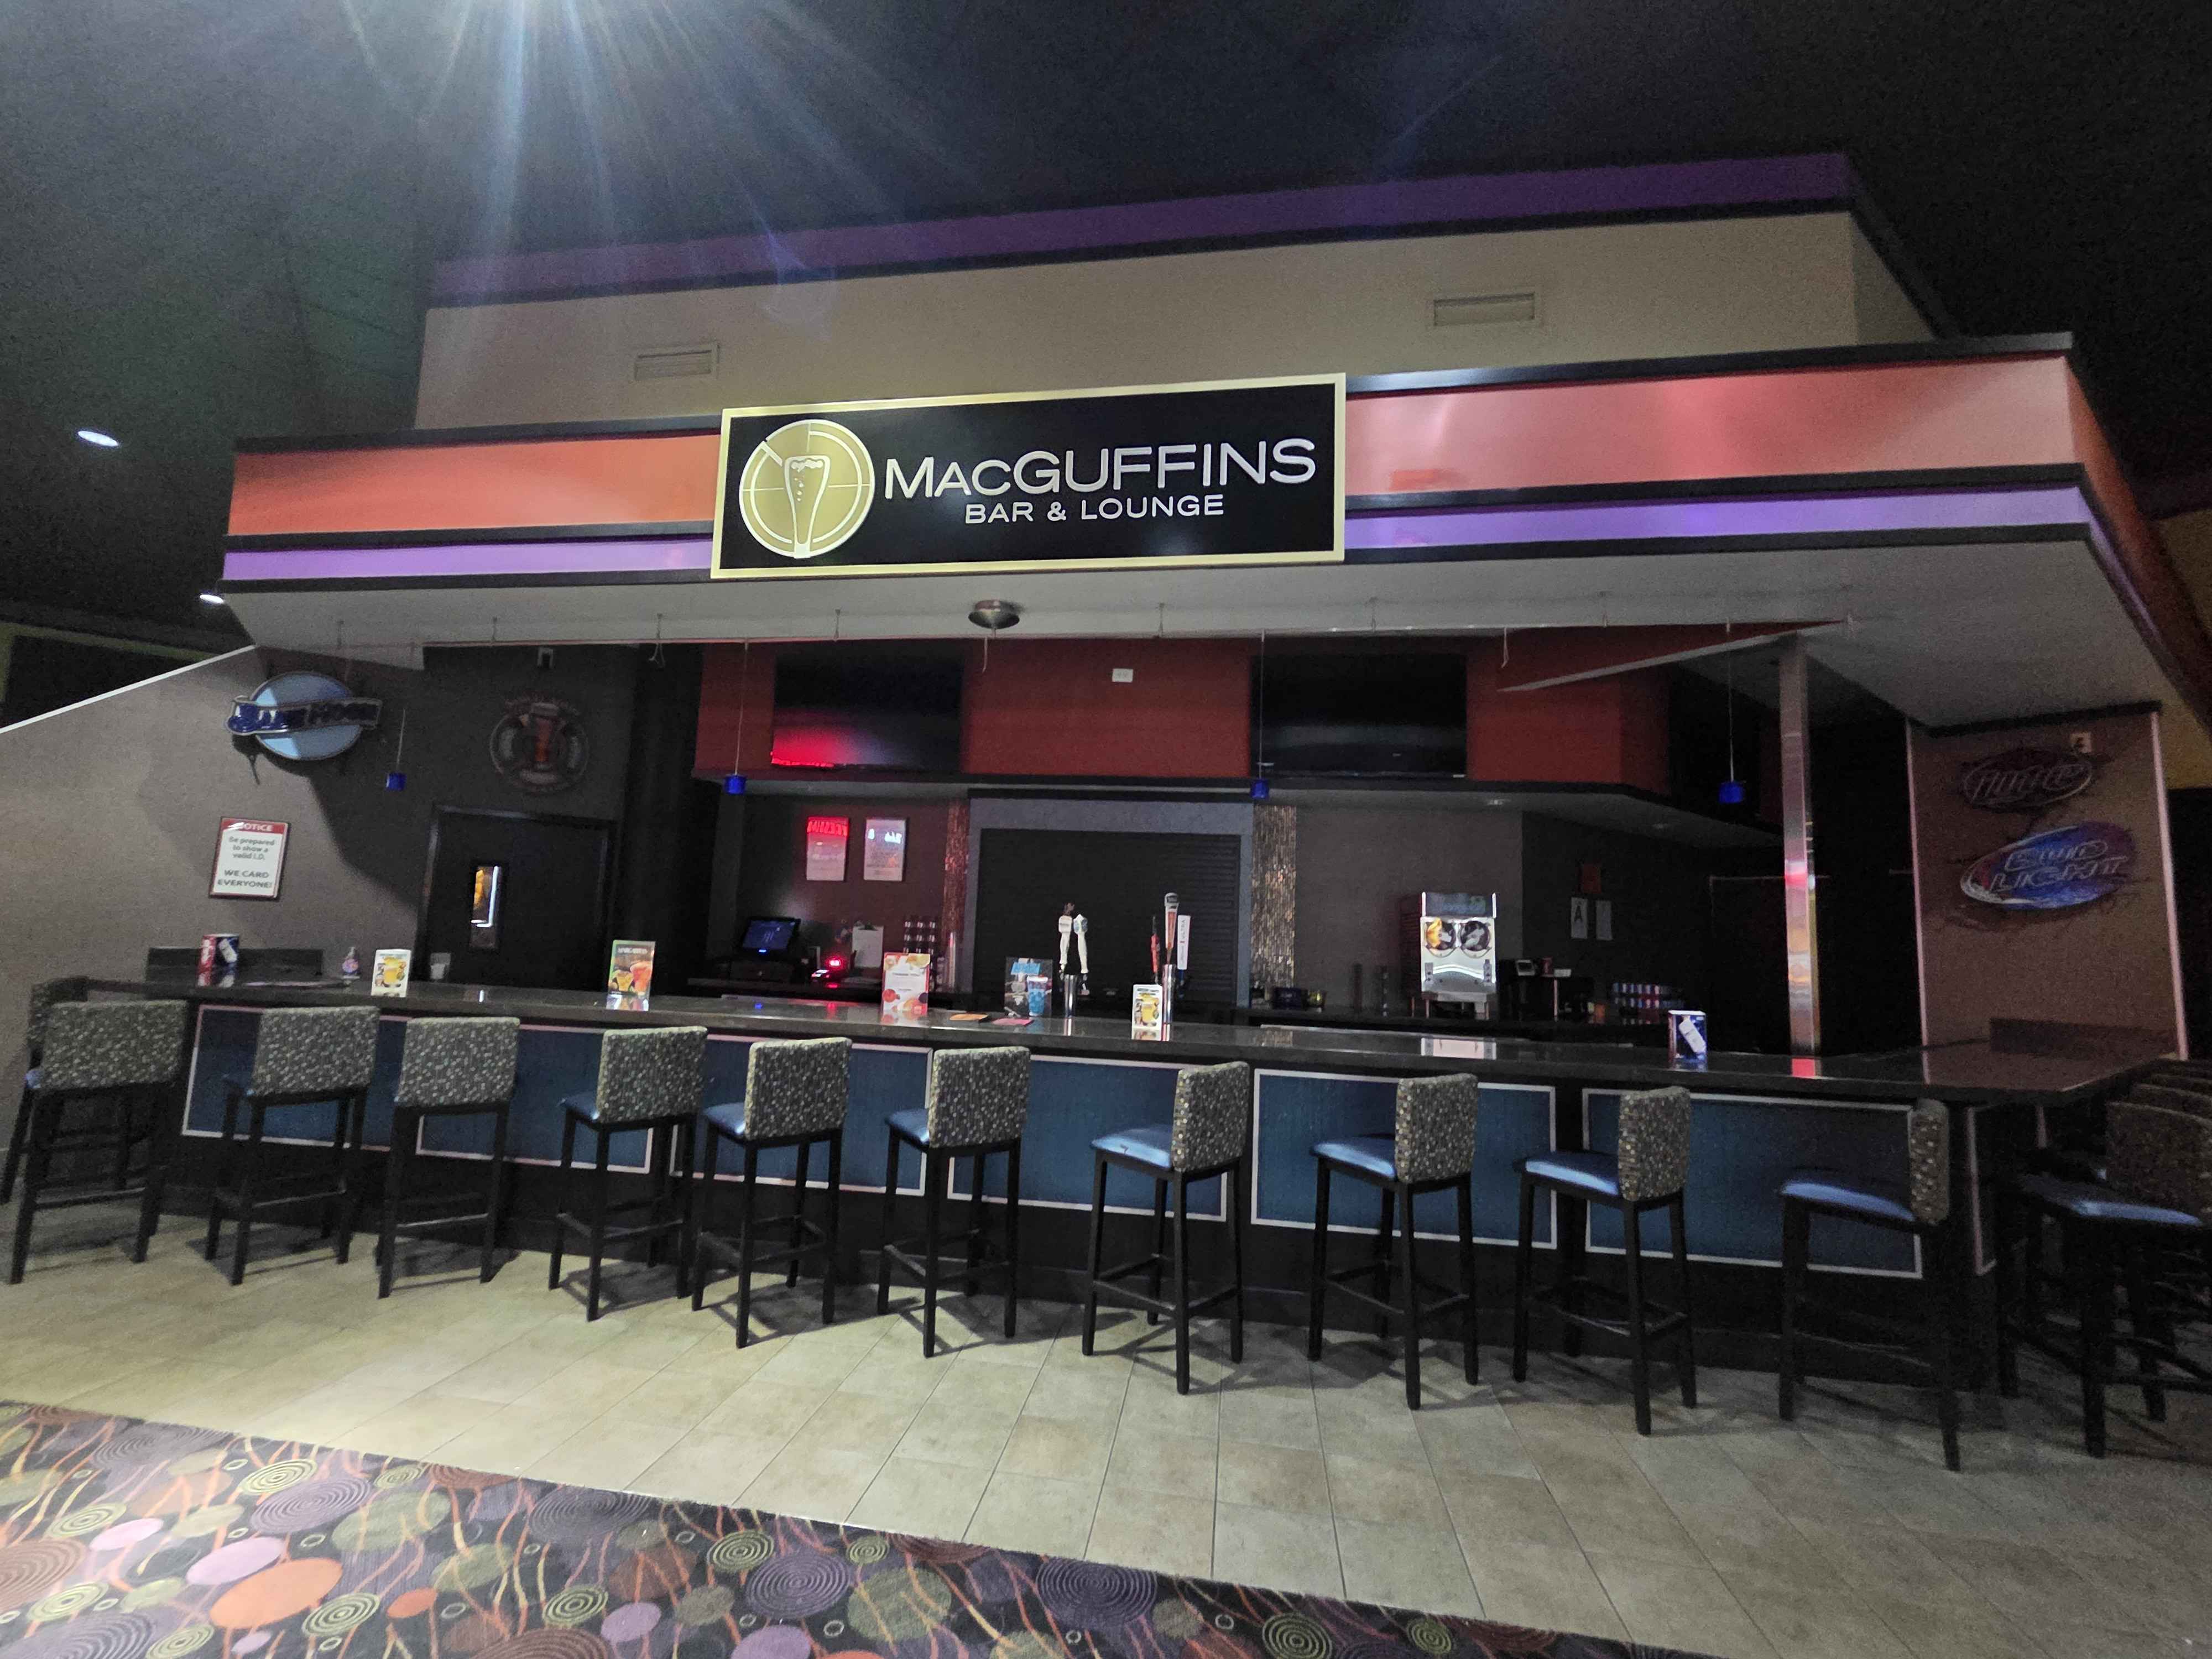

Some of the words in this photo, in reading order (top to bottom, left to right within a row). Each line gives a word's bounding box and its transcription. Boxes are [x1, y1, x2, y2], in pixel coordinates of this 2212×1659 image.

[884, 438, 1316, 500] MACGUFFINS
[964, 501, 1034, 524] BAR
[1047, 500, 1067, 521] &
[1081, 493, 1224, 520] LOUNGE
[237, 822, 273, 831] OTICE
[217, 879, 273, 888] EVERYONE!
